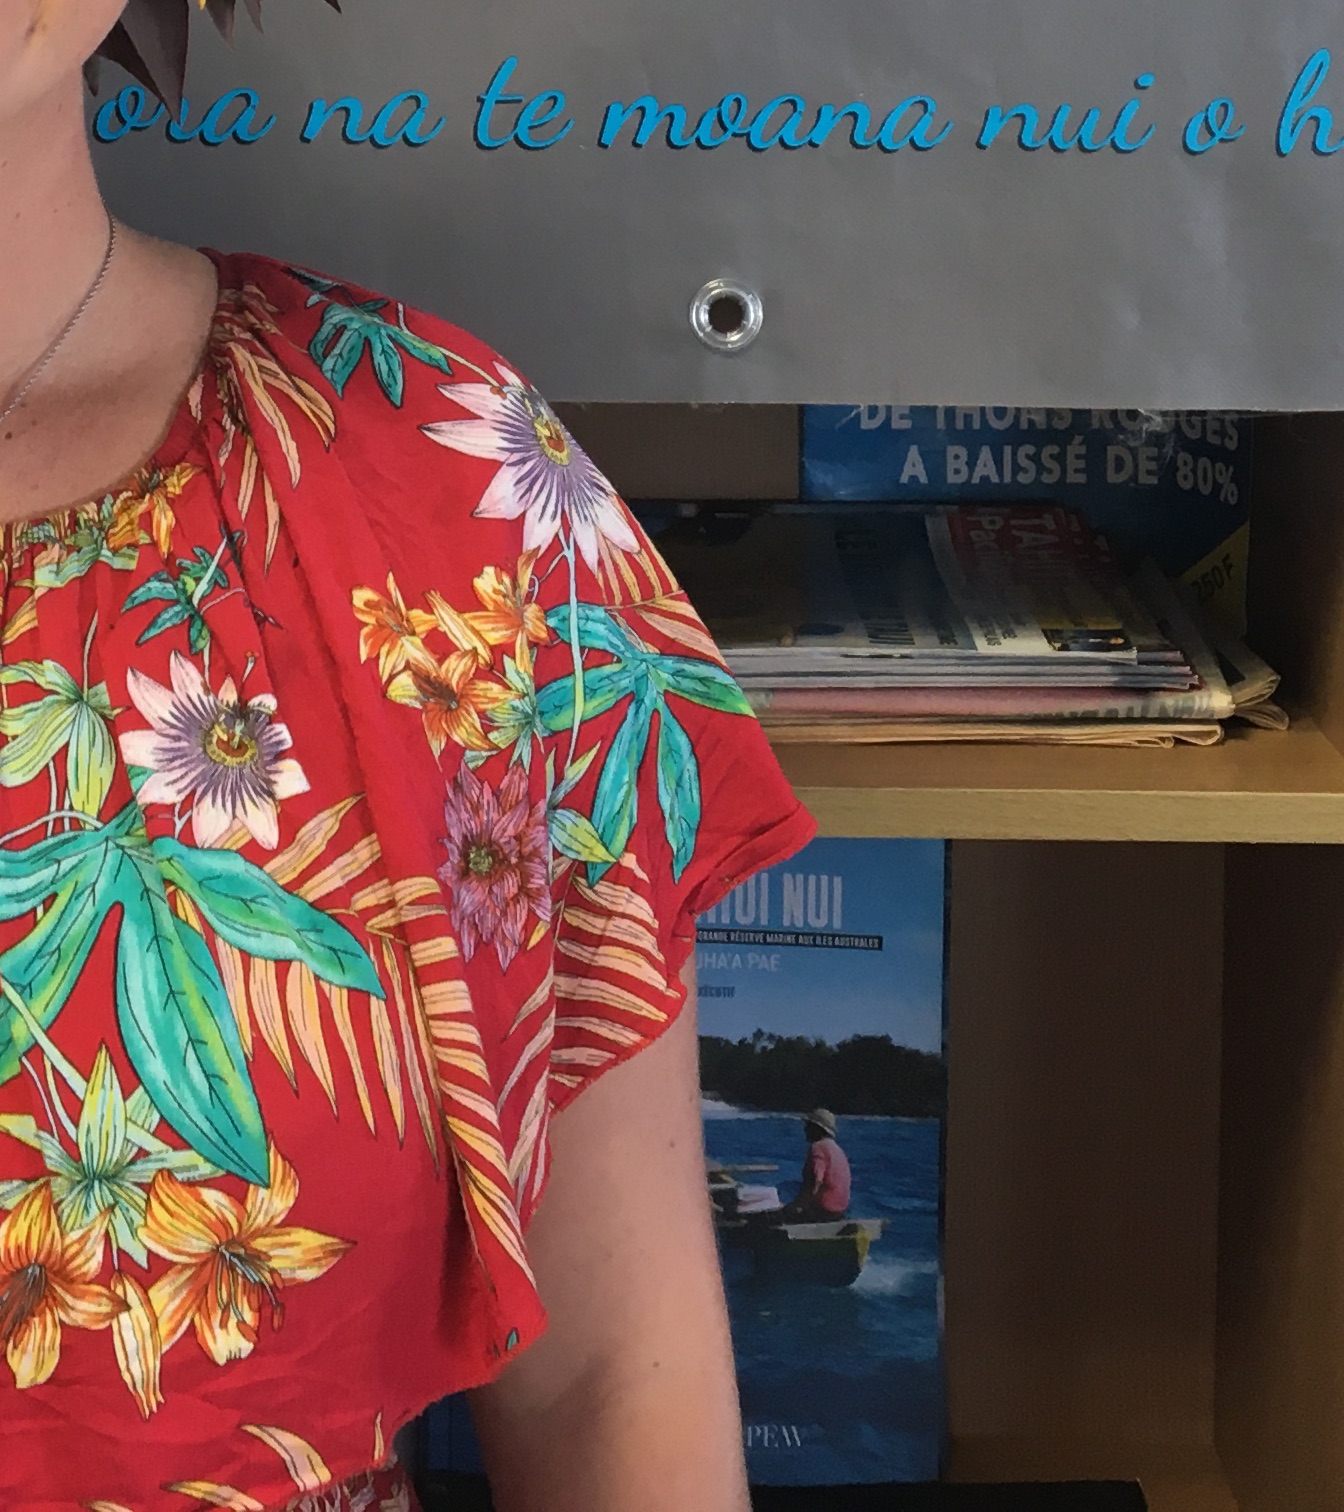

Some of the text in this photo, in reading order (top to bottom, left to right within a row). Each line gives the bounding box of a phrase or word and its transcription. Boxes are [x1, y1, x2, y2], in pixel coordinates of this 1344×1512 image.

[300, 89, 447, 148] na
[473, 55, 575, 151] te
[597, 92, 954, 154] moana
[975, 73, 1156, 154] nui
[1182, 97, 1247, 156] o
[860, 404, 913, 431] DE
[934, 404, 1070, 431] THONS
[898, 434, 1239, 505] A BAISSÉ DE 80%
[783, 872, 842, 930] NUI
[747, 952, 781, 973] PAE
[747, 1425, 801, 1448] PEW
